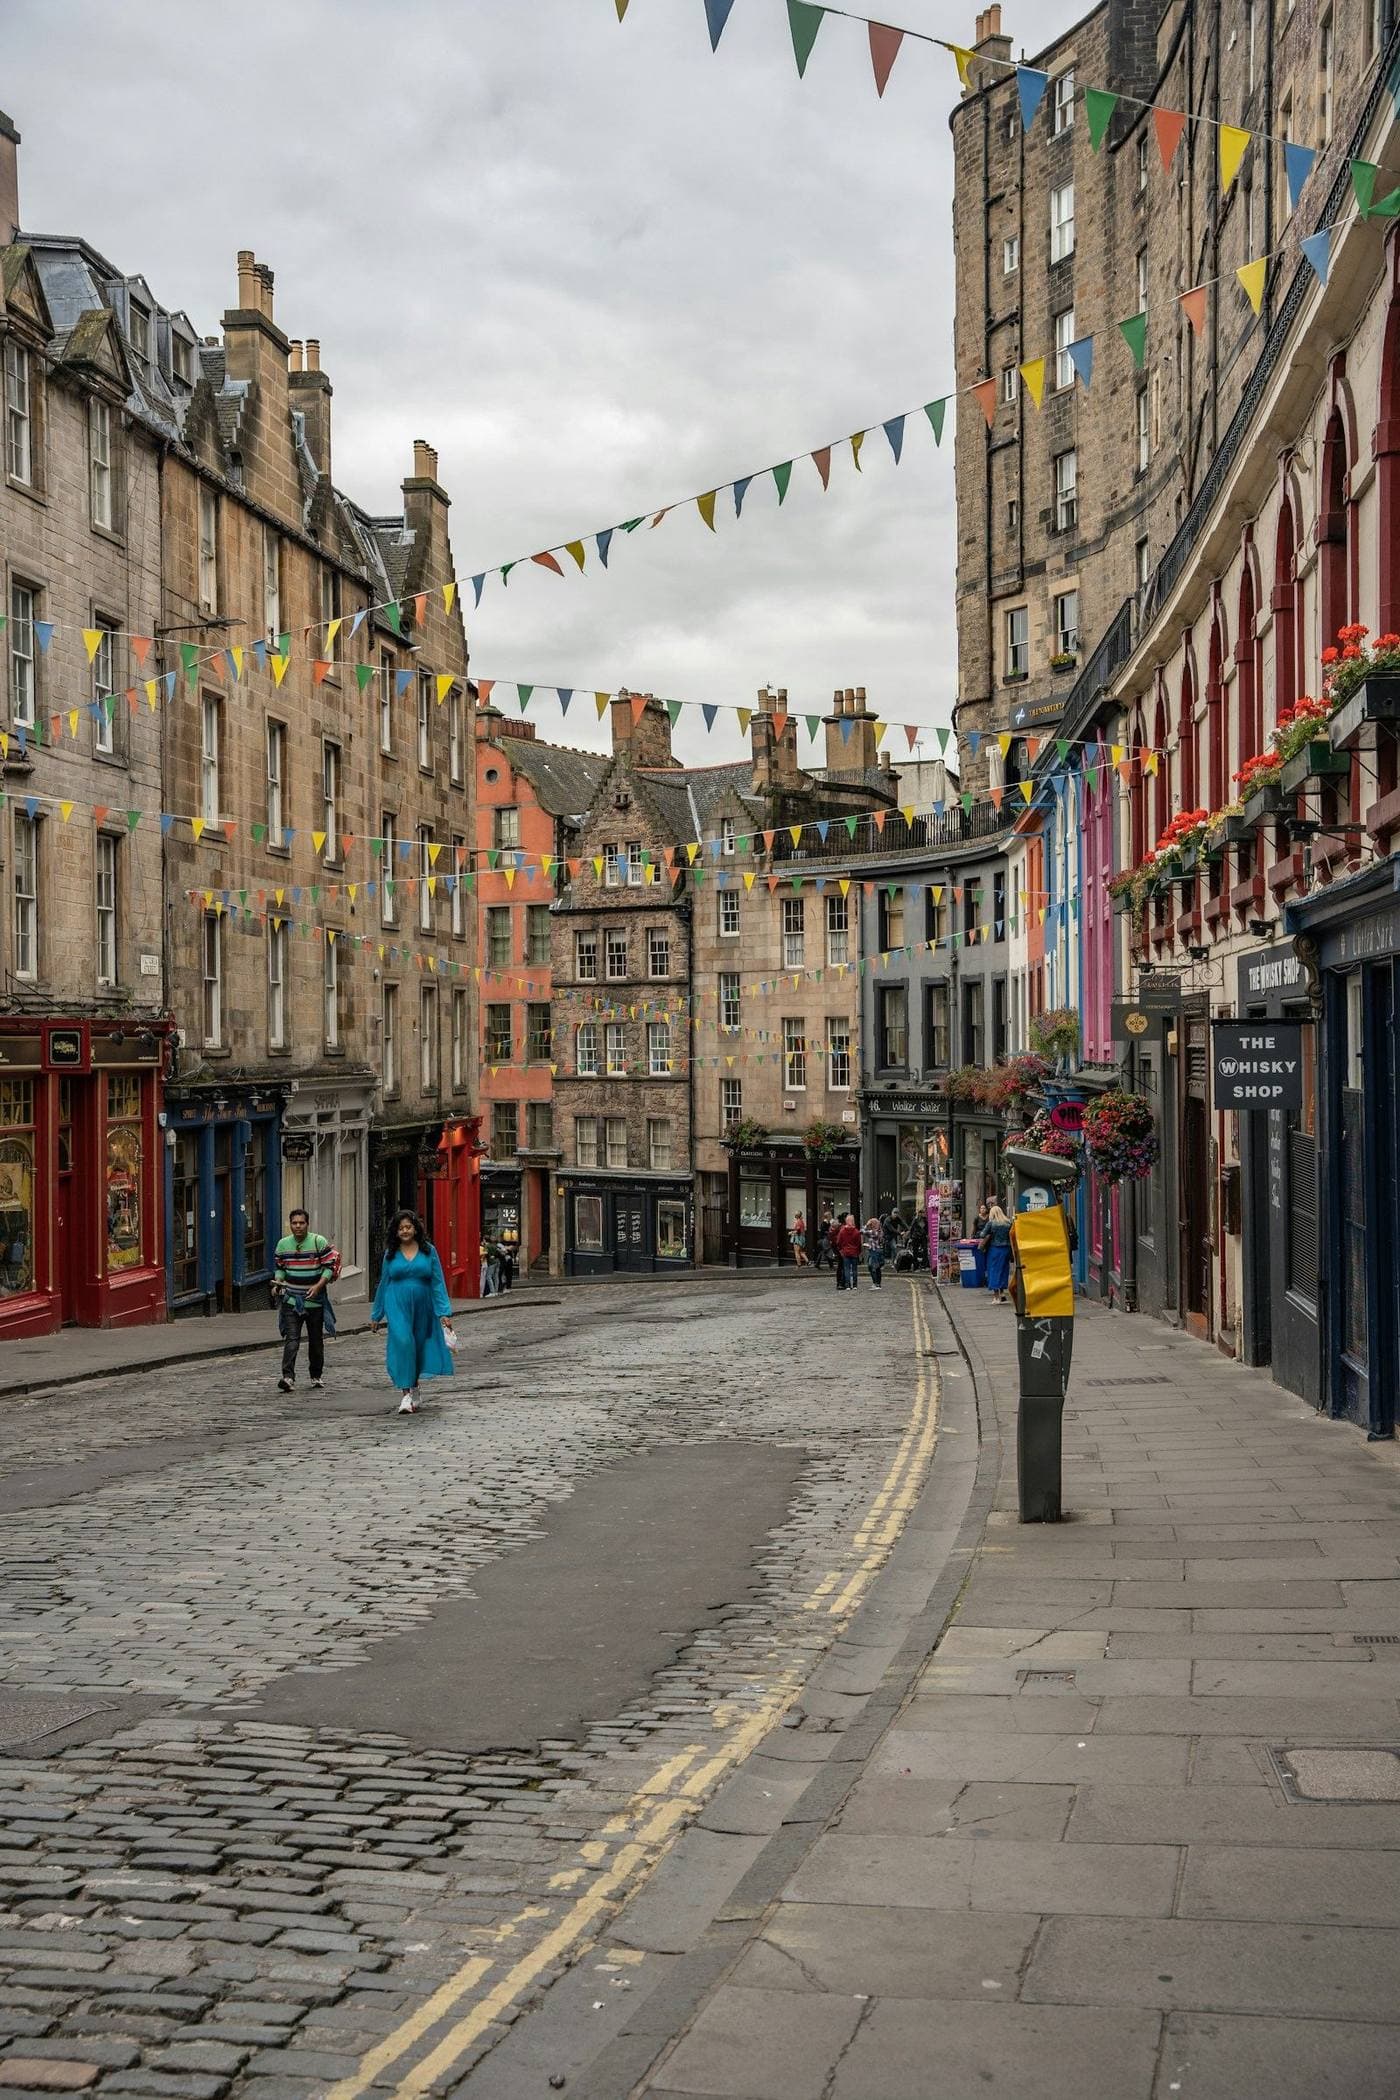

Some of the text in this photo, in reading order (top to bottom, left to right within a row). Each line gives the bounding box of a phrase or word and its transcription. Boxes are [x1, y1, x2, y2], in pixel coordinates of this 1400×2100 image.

[1249, 956, 1300, 992] THE WHISKY SHOP
[1240, 1037, 1275, 1049] THE
[1219, 1059, 1297, 1075] WHISKY
[1233, 1085, 1283, 1098] SHOP
[892, 1101, 917, 1111] Walker
[920, 1101, 941, 1112] Slater
